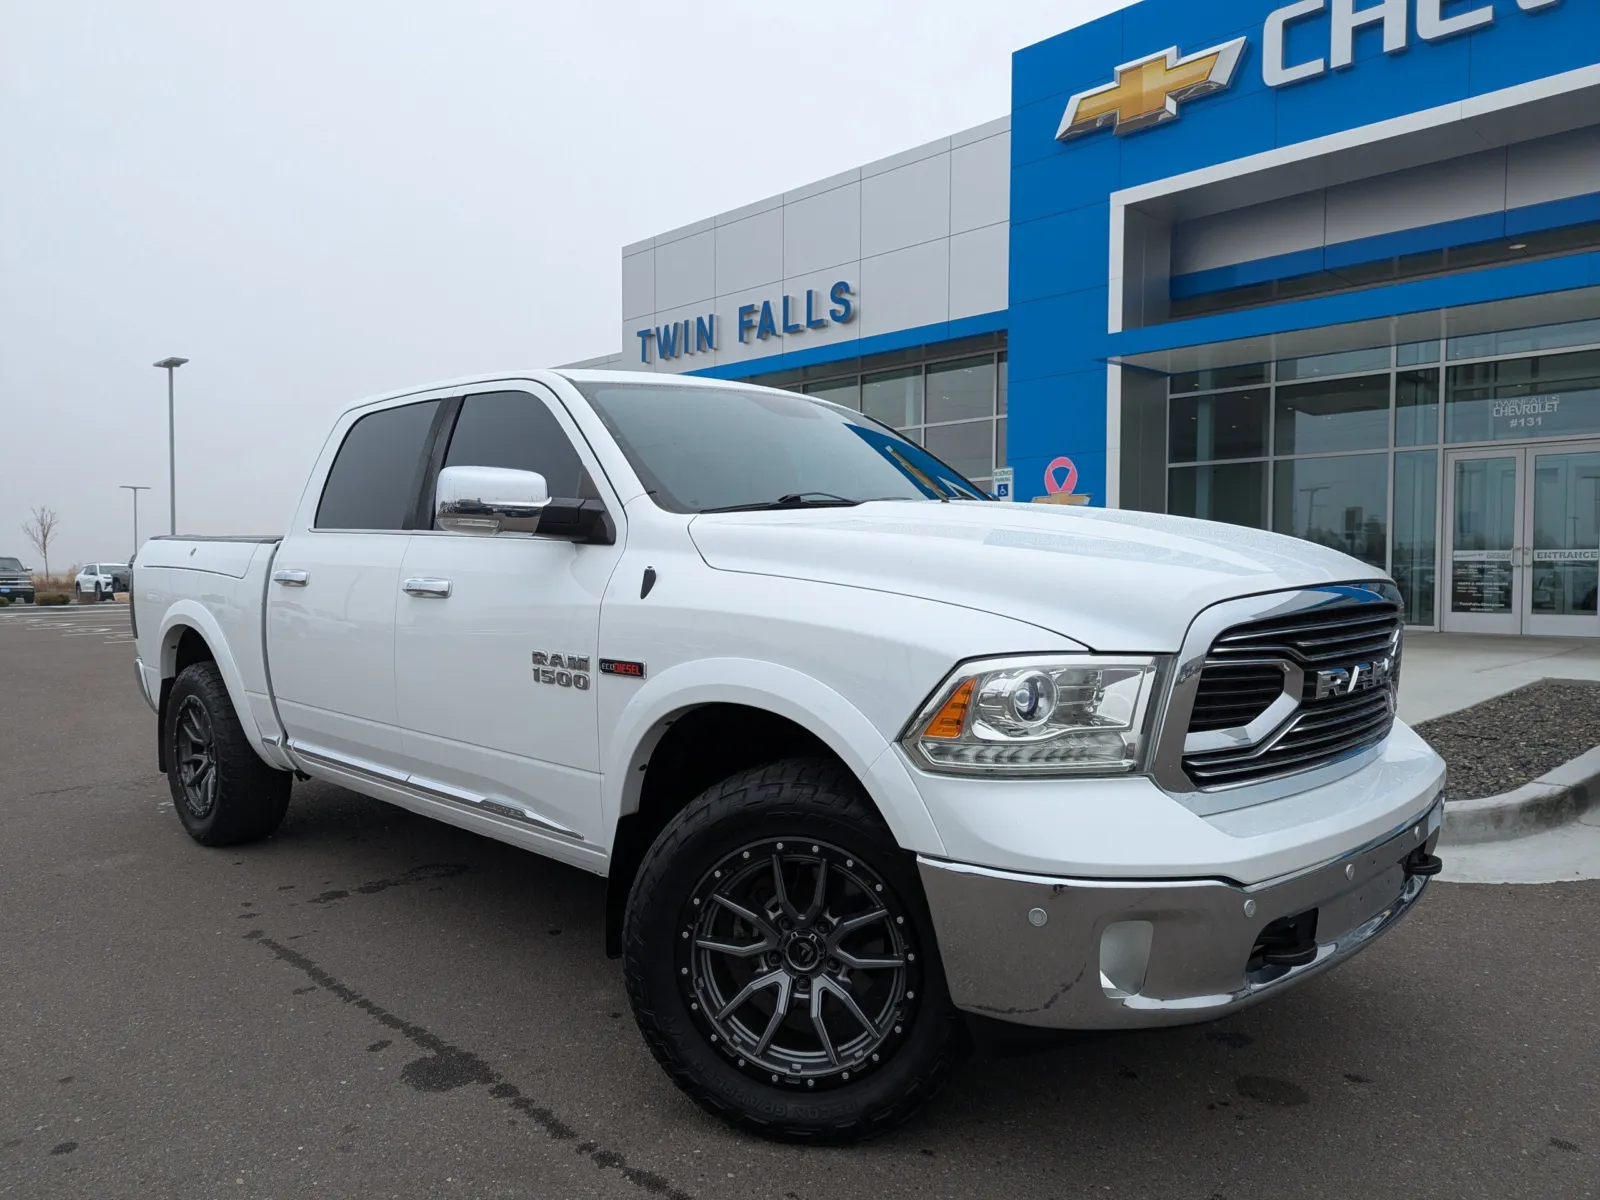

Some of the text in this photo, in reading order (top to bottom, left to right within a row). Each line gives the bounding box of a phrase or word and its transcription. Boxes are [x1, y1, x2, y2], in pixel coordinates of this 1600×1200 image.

[1262, 0, 1558, 87] CH
[637, 280, 856, 364] TWIN FALLS
[1493, 401, 1560, 417] CHEVROLET
[1509, 416, 1542, 428] #131
[1536, 551, 1598, 559] ENTRANCE
[532, 649, 590, 672] RAM
[532, 667, 590, 690] 1500
[1315, 657, 1390, 700] RAM
